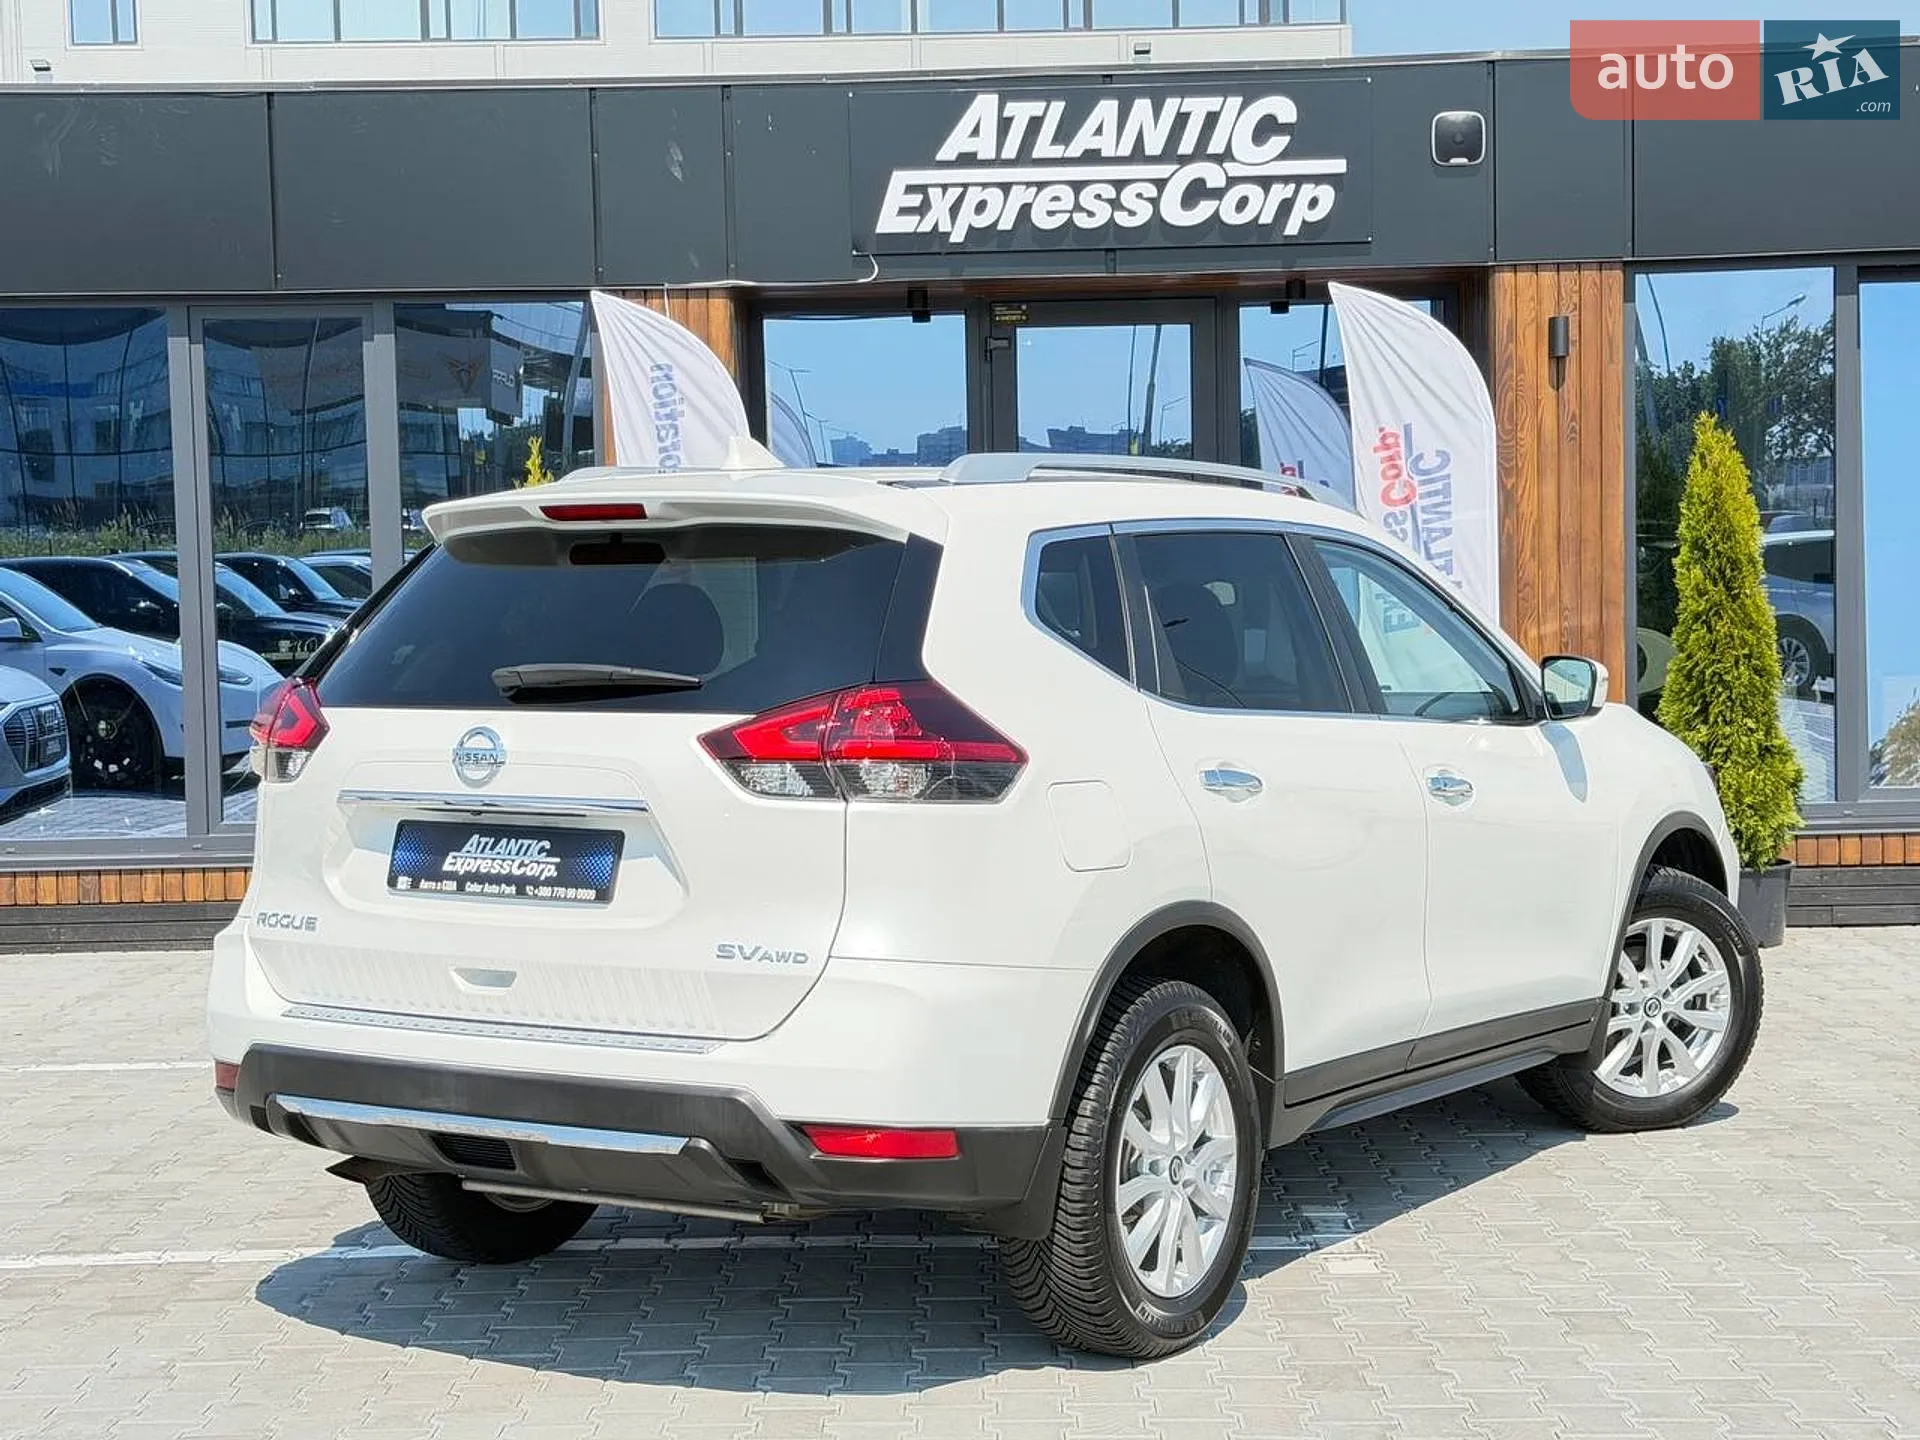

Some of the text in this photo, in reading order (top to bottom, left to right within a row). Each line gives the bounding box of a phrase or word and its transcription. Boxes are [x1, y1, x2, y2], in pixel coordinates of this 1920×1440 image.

[935, 93, 1298, 165] ATLANTIC
[875, 161, 1335, 243] ExpressCorp
[452, 751, 498, 762] NISSAN
[461, 833, 551, 857] ATLANTIC
[442, 852, 558, 880] ExpressCorp.
[500, 883, 516, 895] Park
[257, 912, 318, 932] ROGUE
[758, 949, 809, 964] AWD
